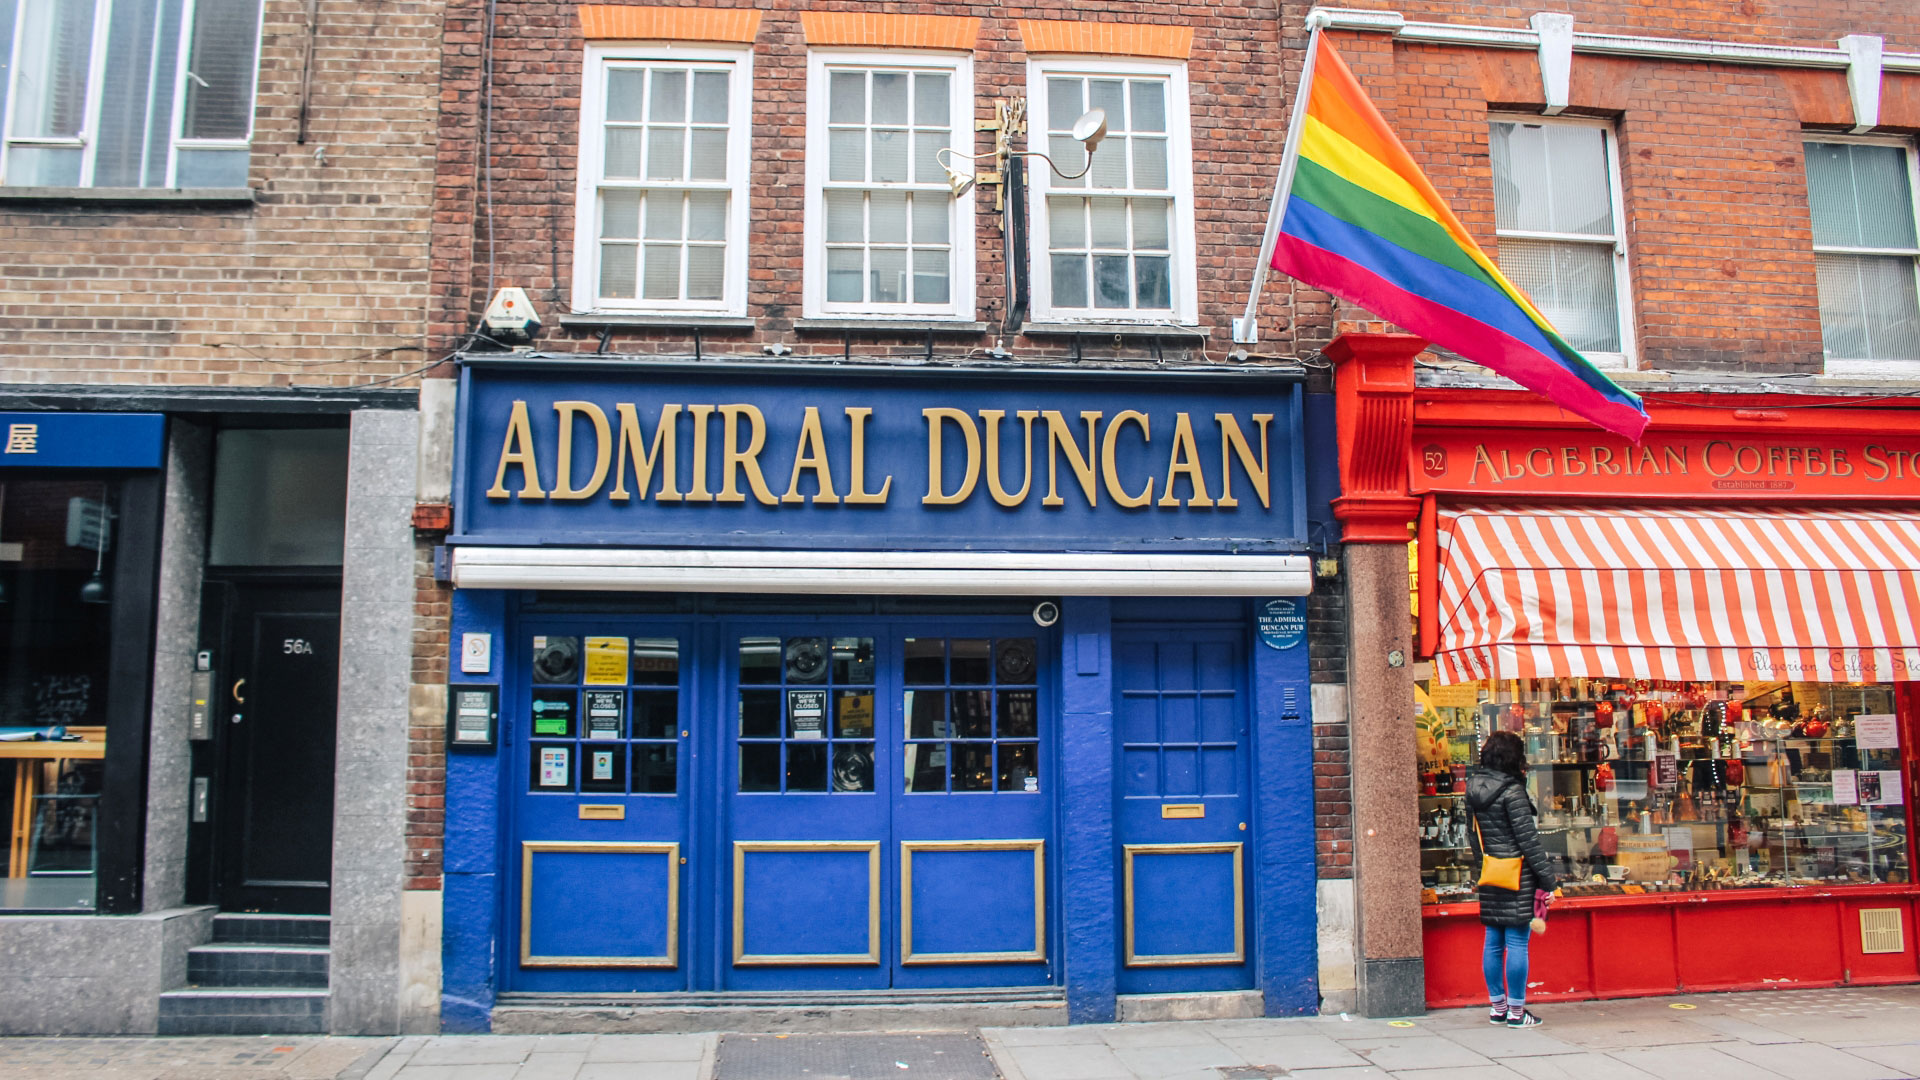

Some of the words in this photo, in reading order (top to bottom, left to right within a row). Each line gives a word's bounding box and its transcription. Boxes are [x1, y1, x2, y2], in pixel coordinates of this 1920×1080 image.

[4, 423, 39, 454] 屋
[485, 400, 892, 506] ADMIRAL
[921, 406, 1275, 509] DUNCAN
[1425, 451, 1444, 471] 52
[1468, 443, 1688, 485] ALGERIAN
[1702, 440, 1854, 479] COFFEE
[1717, 480, 1765, 489] Established
[1770, 480, 1788, 489] 1887
[283, 638, 313, 655] 56A
[1748, 651, 1818, 677] Algerian
[1828, 652, 1879, 677] Coffee
[1891, 652, 1920, 672] Sto
